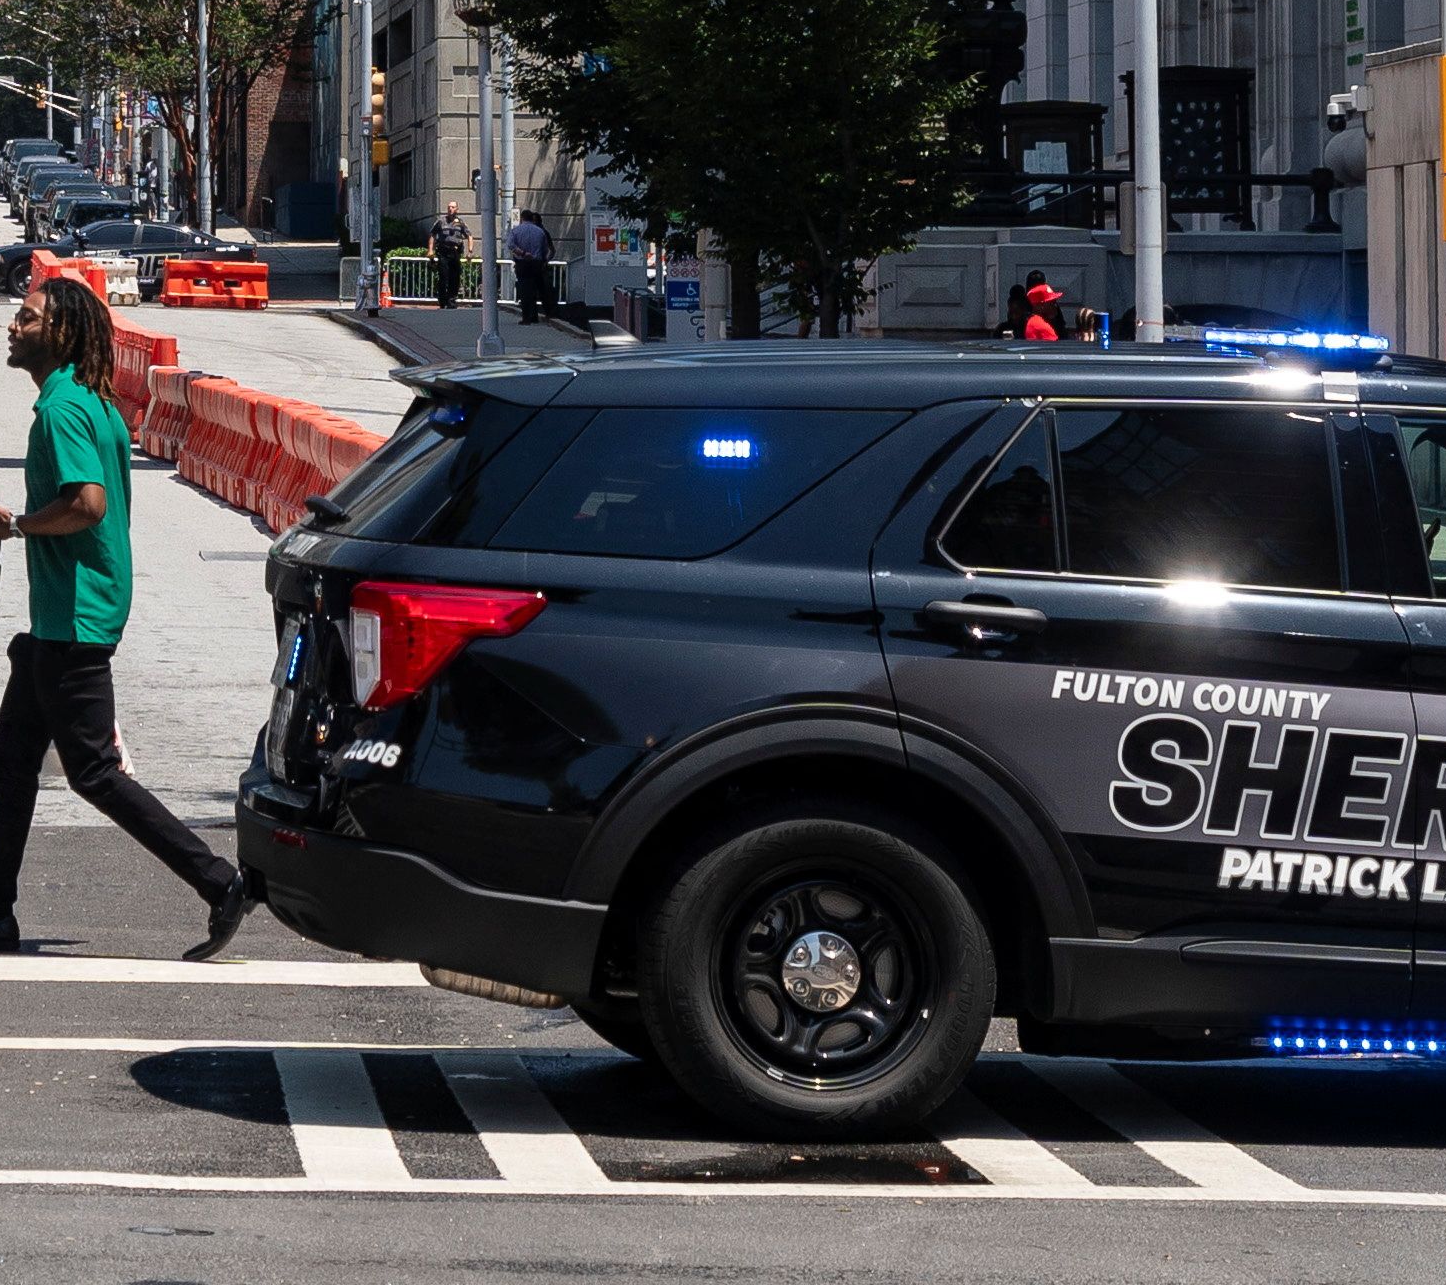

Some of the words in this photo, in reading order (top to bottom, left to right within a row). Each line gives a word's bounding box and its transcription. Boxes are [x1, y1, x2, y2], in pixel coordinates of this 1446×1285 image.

[1051, 671, 1185, 709] FULTON
[1193, 682, 1330, 721] COUNTY
[343, 737, 402, 768] A006
[1218, 847, 1413, 901] PATRICK
